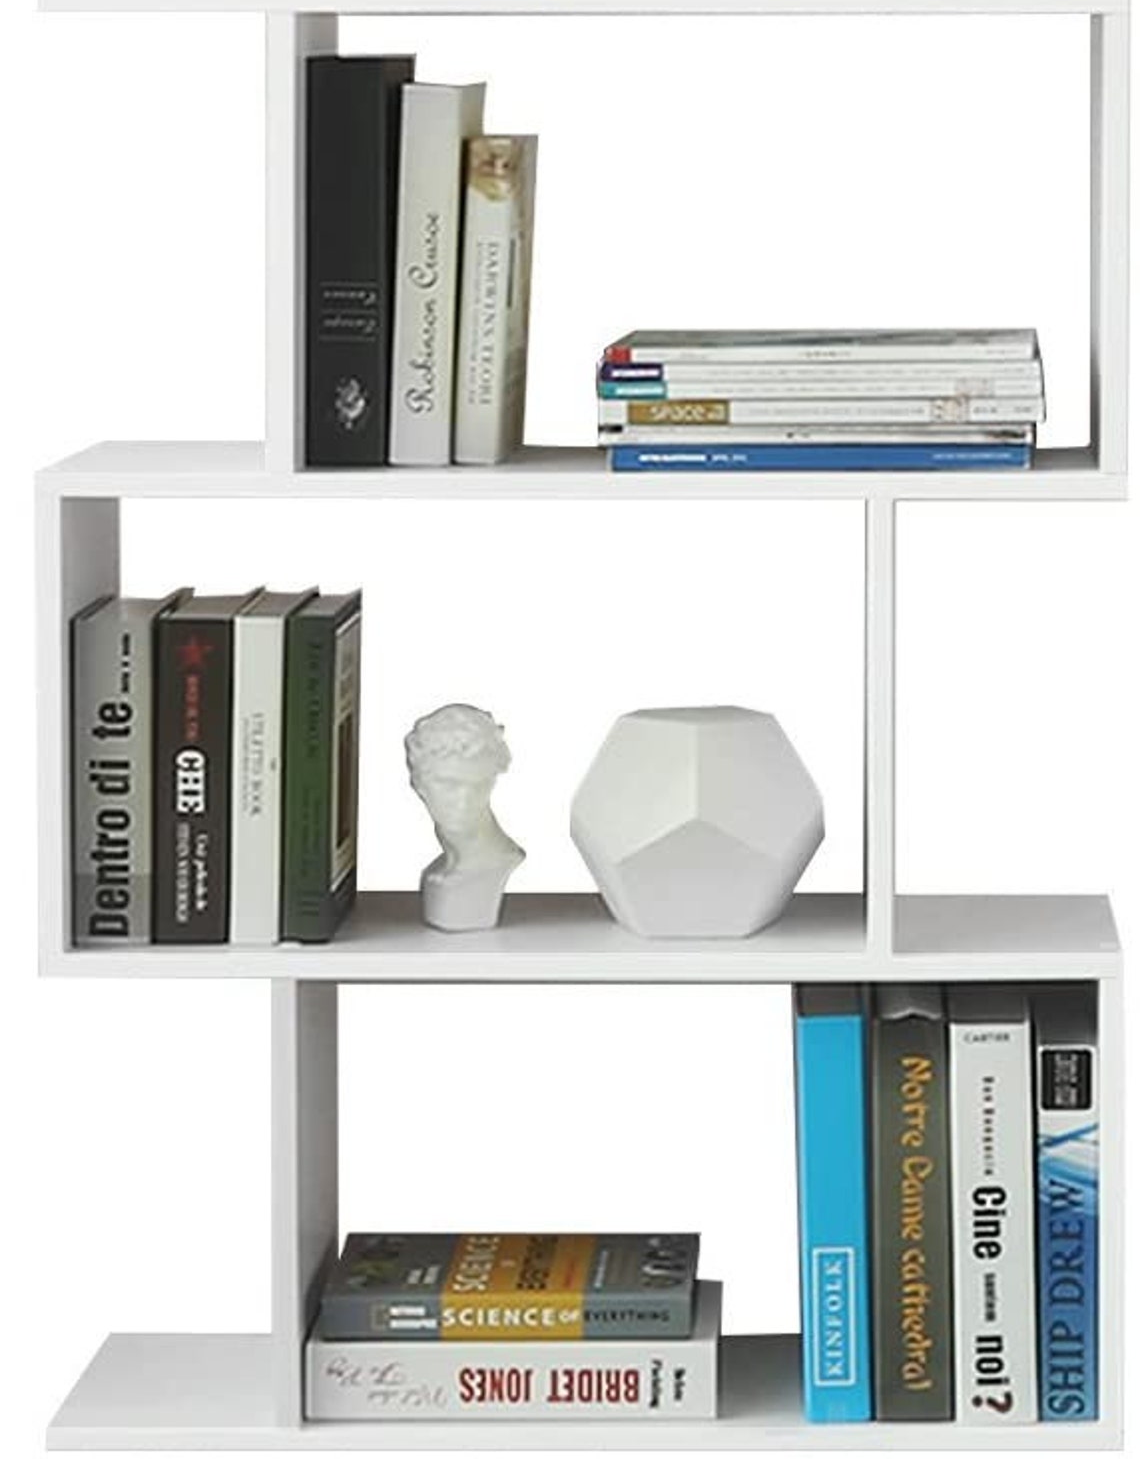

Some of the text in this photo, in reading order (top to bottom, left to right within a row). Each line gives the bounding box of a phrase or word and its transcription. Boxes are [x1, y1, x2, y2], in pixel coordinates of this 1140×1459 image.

[404, 298, 436, 414] Robinson
[89, 702, 132, 937] Dentro di te
[176, 749, 206, 815] CHE
[901, 1055, 932, 1147] Notre
[973, 1186, 1006, 1260] Cine
[441, 1307, 555, 1327] SCIENCE
[584, 1309, 670, 1323] EVERYTHING
[824, 1258, 843, 1379] KINFOLK
[901, 1247, 933, 1390] cathedral
[1049, 1179, 1085, 1415] SHIP DREW
[460, 1368, 640, 1403] BRIDET JONES
